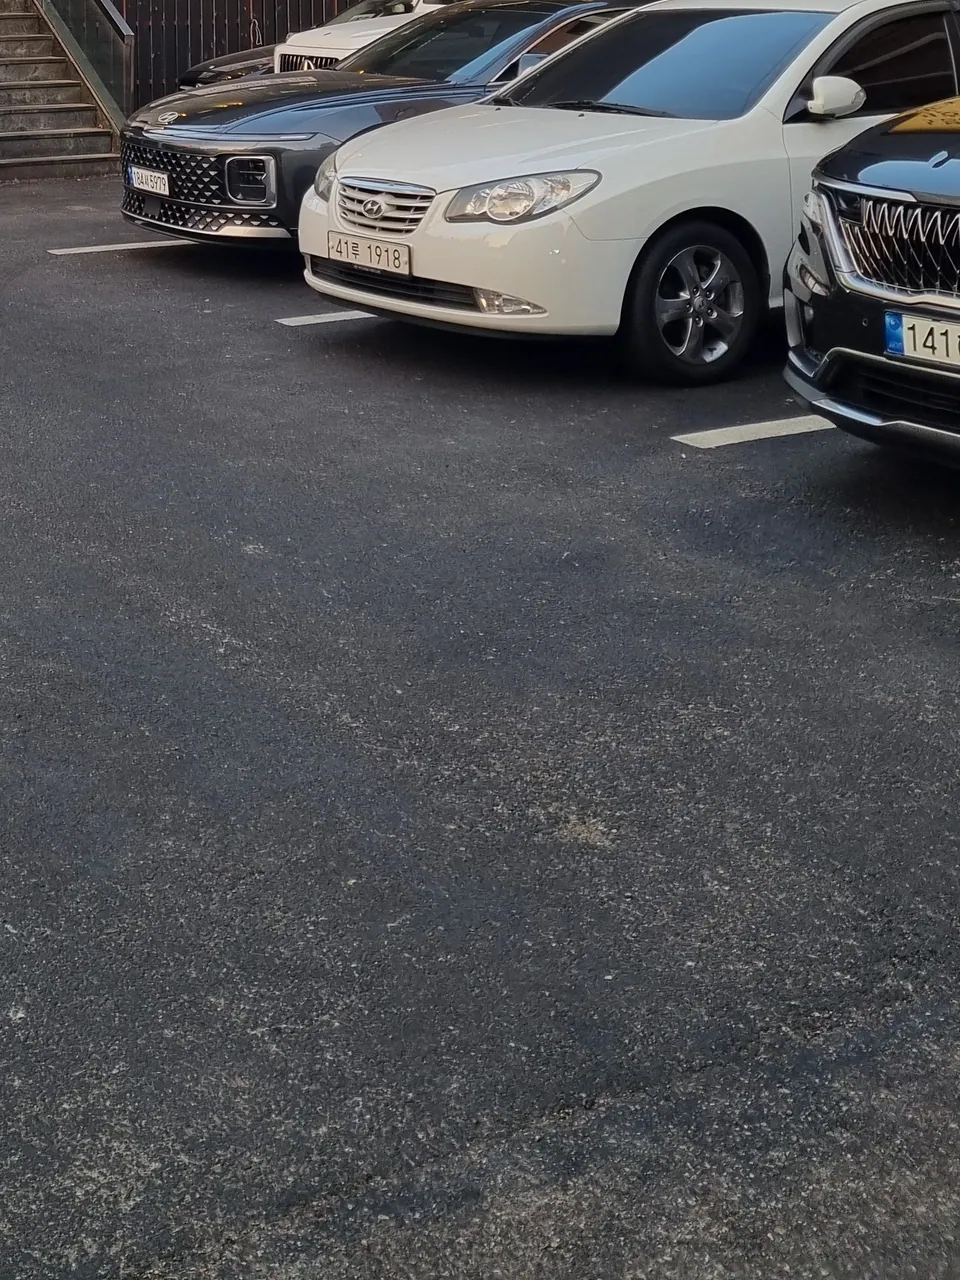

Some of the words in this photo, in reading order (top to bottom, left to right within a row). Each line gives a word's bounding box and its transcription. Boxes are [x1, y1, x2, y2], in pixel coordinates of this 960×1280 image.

[335, 238, 360, 260] 41루
[367, 243, 402, 269] 1918
[906, 323, 960, 358] 141
